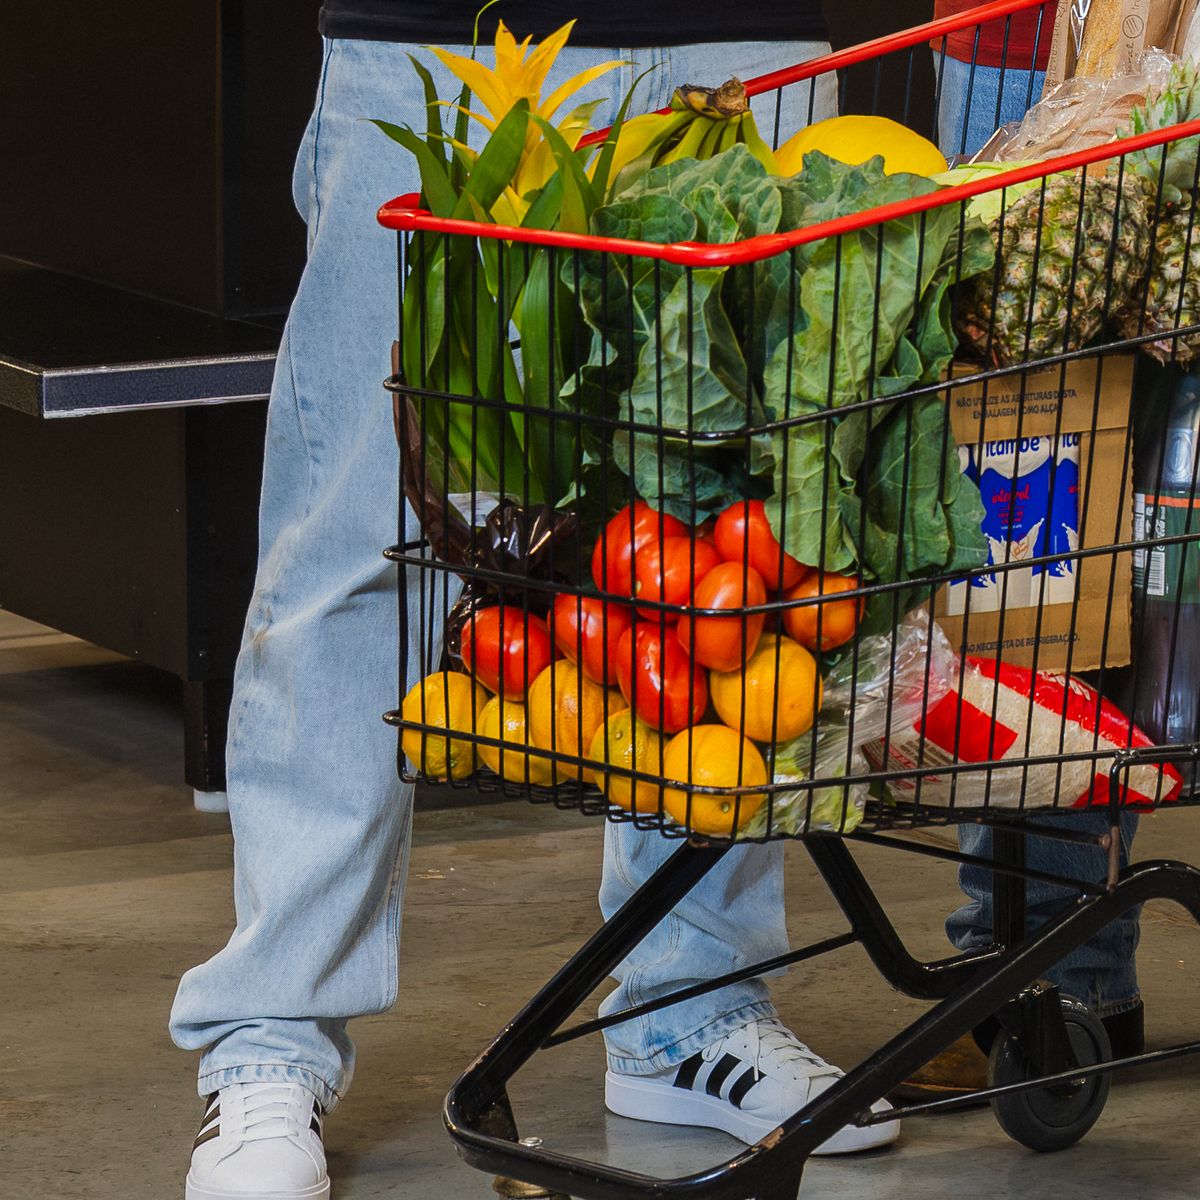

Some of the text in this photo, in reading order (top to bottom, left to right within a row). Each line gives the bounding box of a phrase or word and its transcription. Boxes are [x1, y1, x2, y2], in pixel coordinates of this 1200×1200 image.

[1000, 394, 1010, 404] AS
[1054, 389, 1077, 400] DSTA
[1018, 404, 1039, 416] OMO
[991, 483, 1031, 504] interal
[1015, 638, 1025, 649] DE
